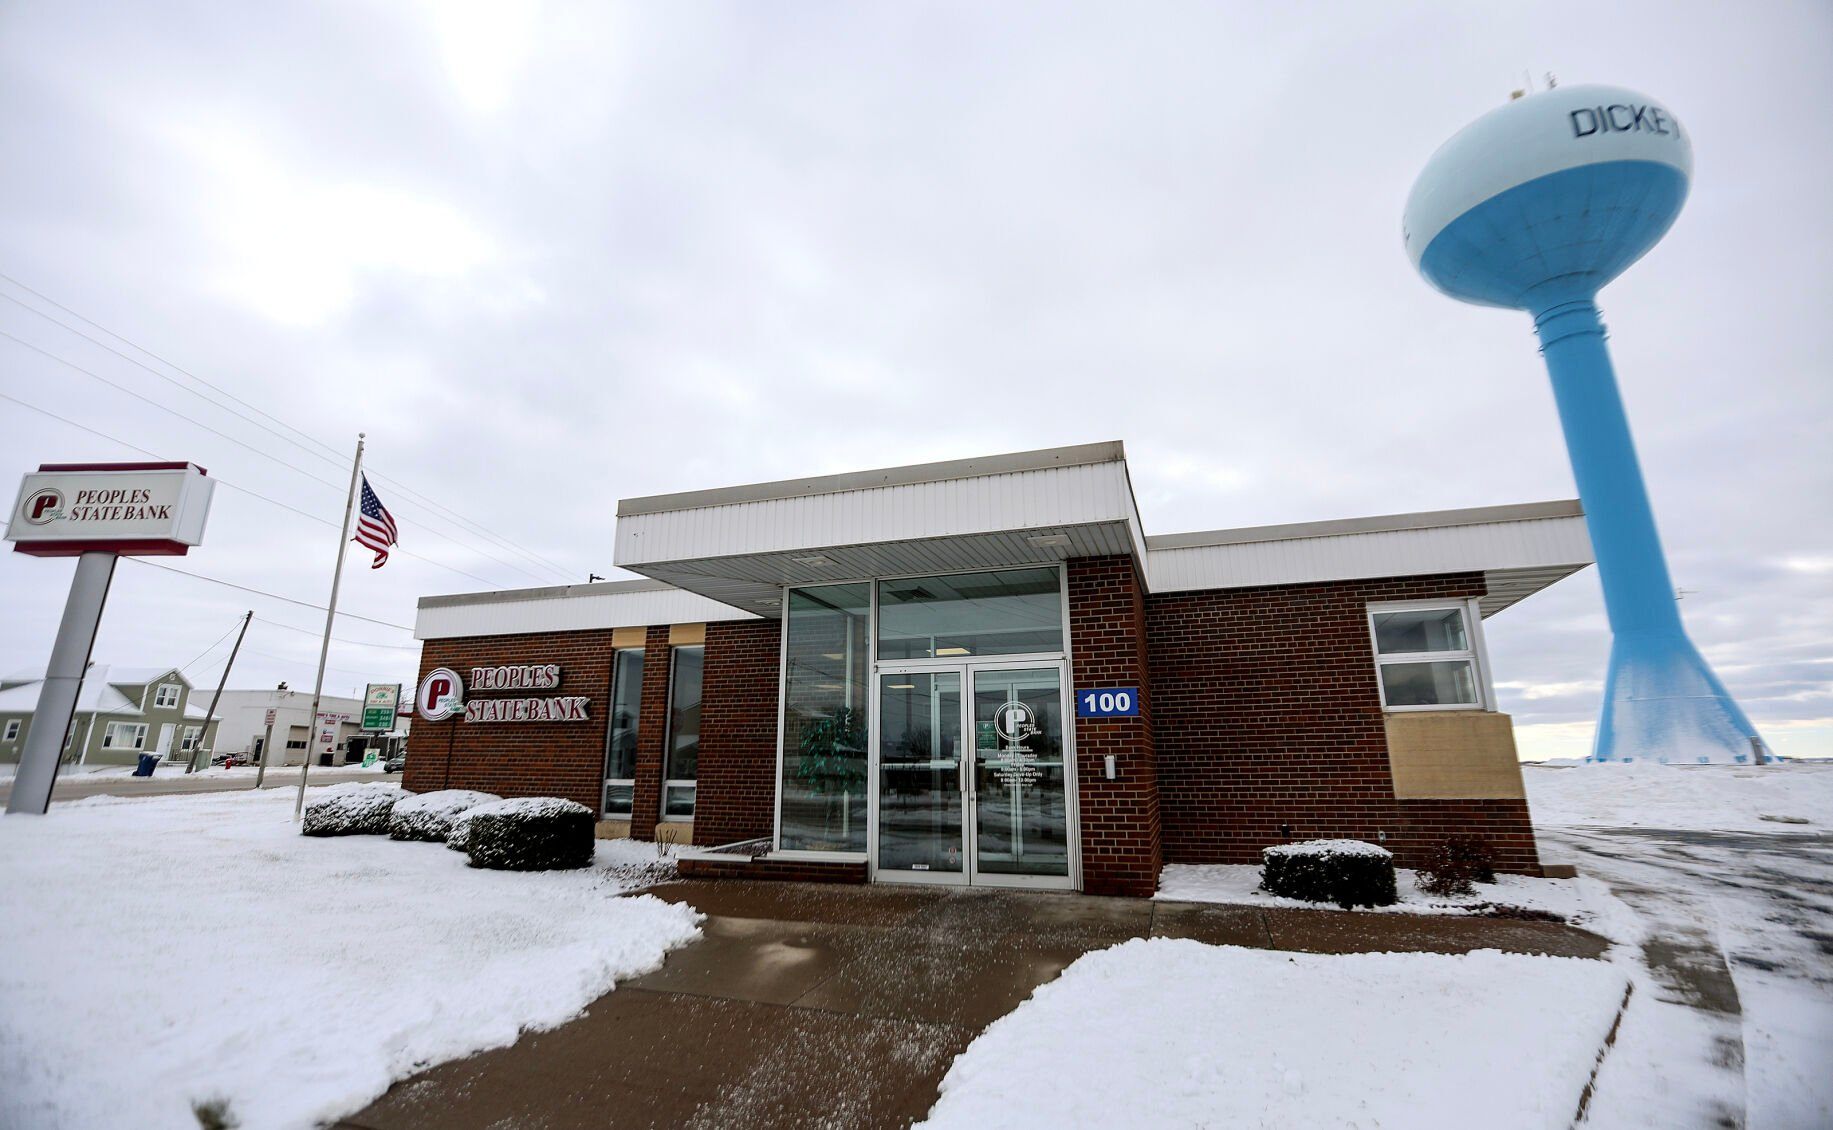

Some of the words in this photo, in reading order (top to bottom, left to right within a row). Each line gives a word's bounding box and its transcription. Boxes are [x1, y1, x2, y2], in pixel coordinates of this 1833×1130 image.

[31, 495, 59, 519] P
[75, 488, 151, 504] PEOPLES
[69, 505, 123, 521] STATE
[123, 504, 172, 521] BANK
[471, 665, 557, 690] PEOPLES
[427, 679, 451, 710] P
[1084, 692, 1131, 713] 100
[466, 699, 525, 722] STATE
[527, 697, 587, 721] BANK
[1005, 709, 1026, 734] P
